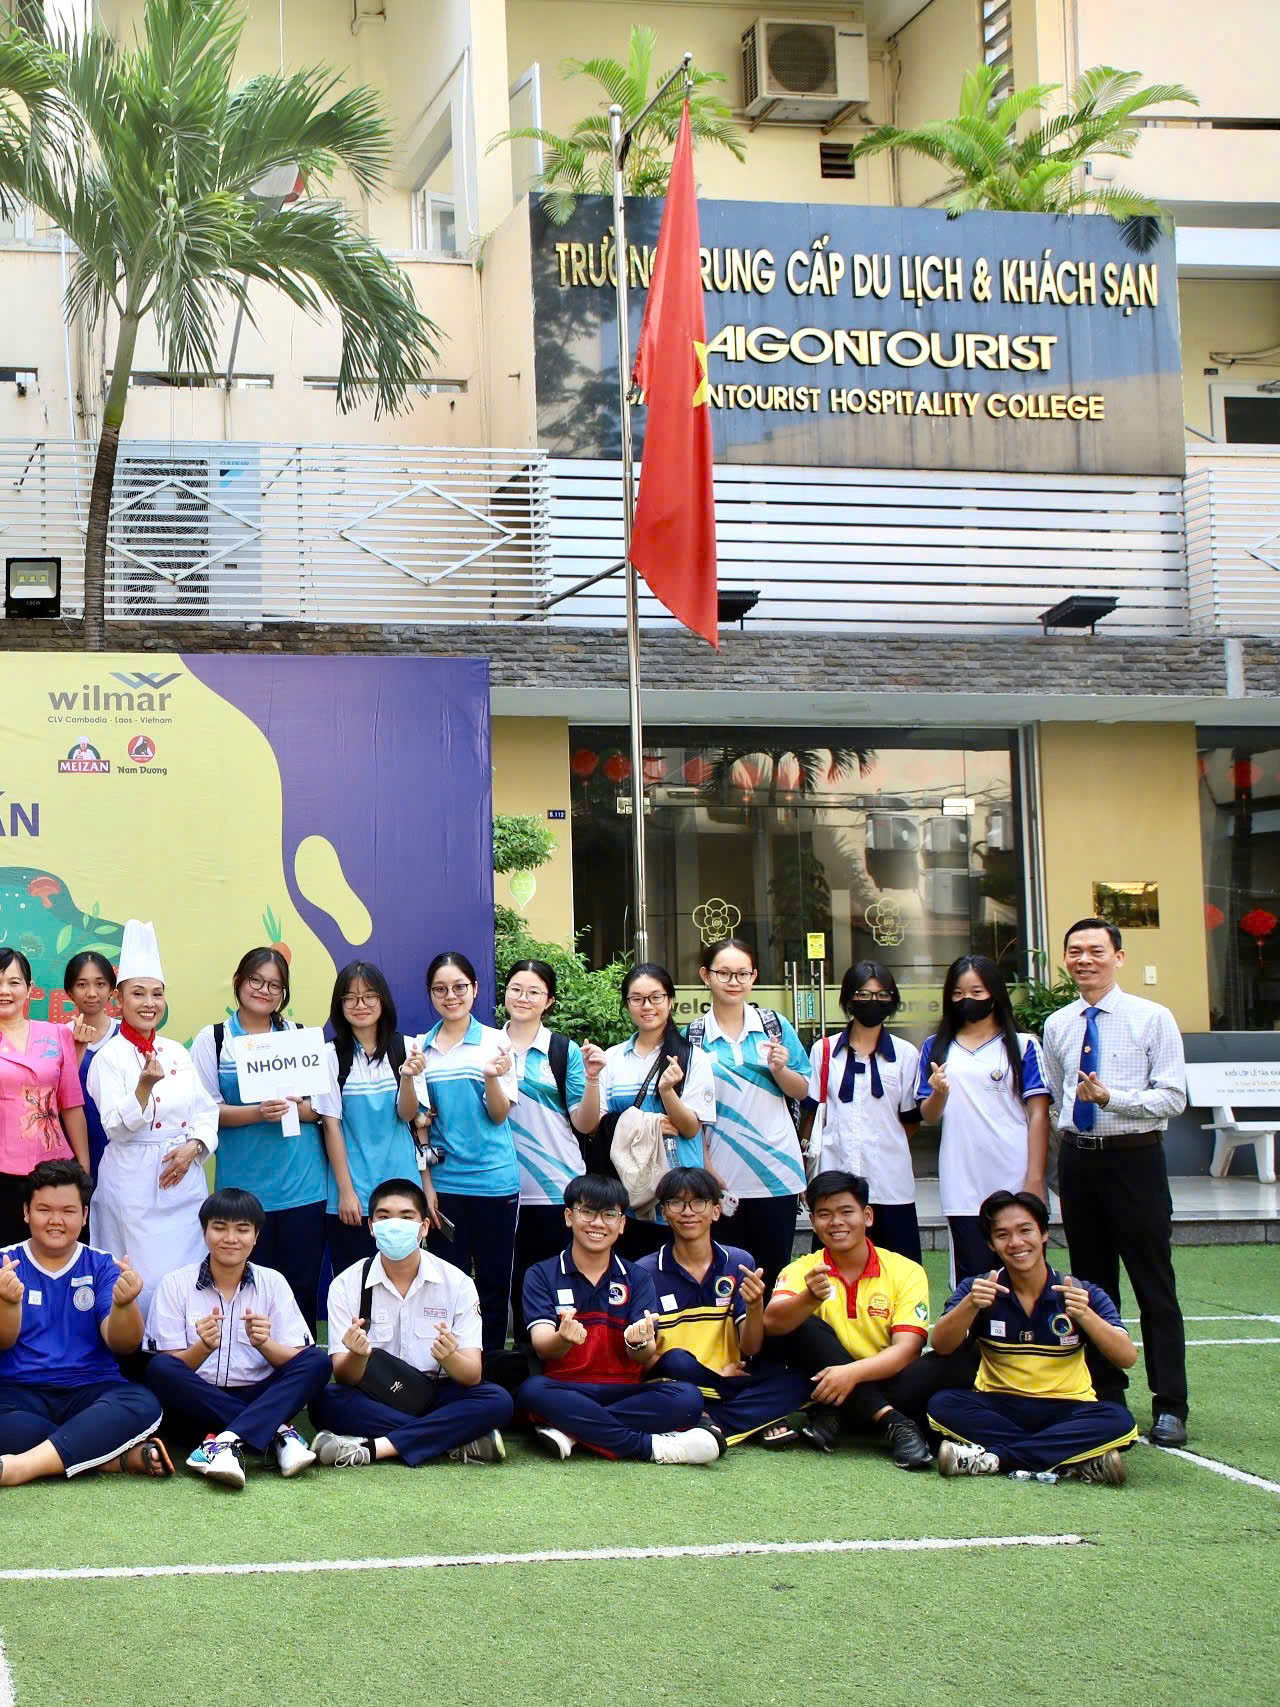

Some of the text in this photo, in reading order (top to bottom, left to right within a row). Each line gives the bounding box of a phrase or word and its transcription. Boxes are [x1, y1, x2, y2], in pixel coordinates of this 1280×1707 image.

[556, 226, 1159, 316] TRƯN RUNG CẤP DU LỊCH & KHÁCH SẠN
[706, 324, 1057, 371] AIGONTOURIST
[830, 388, 980, 417] HOSPITALITY
[986, 394, 1105, 420] COLLEGE
[48, 684, 172, 711] wilmar
[47, 715, 63, 724] CLV
[65, 715, 108, 724] Cambodia
[115, 716, 133, 724] Laos
[140, 716, 173, 724] Vietnam
[59, 761, 109, 772] MEIZAN
[117, 766, 138, 774] Nam
[247, 1054, 320, 1074] NHÓM 02
